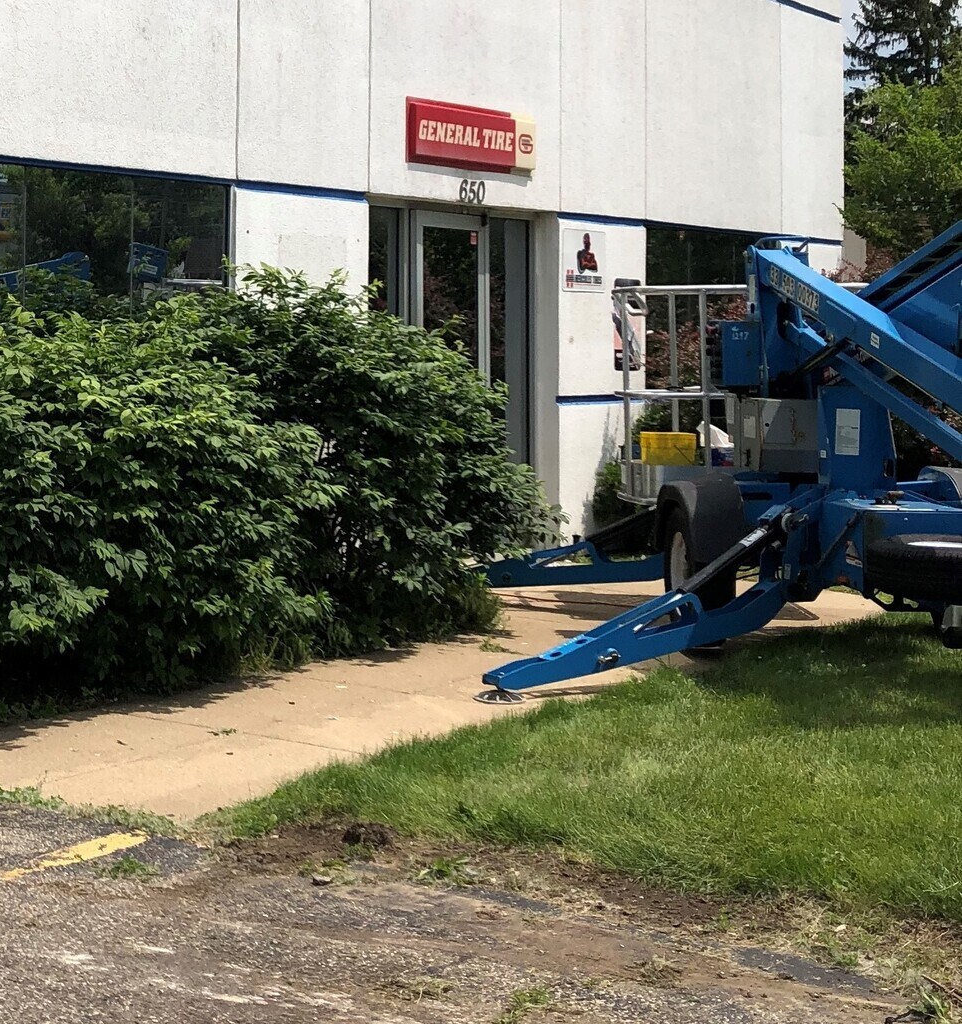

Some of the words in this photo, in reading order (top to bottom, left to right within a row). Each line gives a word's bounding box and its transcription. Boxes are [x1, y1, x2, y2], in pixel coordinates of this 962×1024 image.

[418, 119, 480, 147] GENERAL
[482, 129, 514, 152] TIRE
[459, 179, 486, 204] 650
